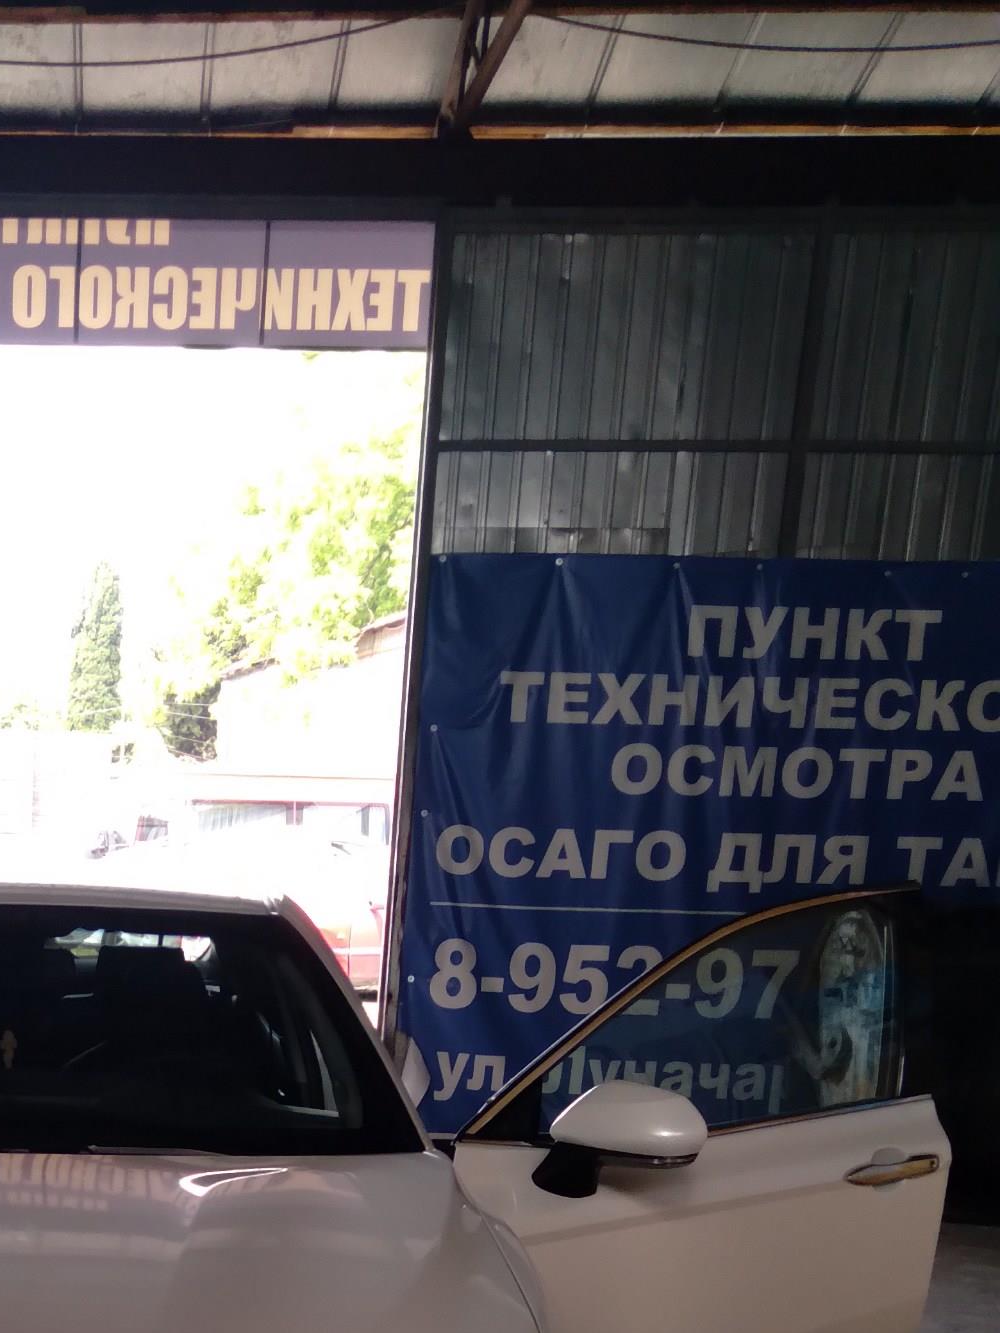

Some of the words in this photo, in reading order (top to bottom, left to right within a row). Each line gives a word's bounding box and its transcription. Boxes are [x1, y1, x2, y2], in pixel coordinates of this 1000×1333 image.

[687, 605, 943, 662] ПУНКТ
[501, 670, 1000, 733] ТЕХНИЧЕСКО
[611, 743, 983, 801] ОСМОТРА
[436, 824, 687, 880] ОСАГО
[706, 832, 870, 893] ДЛЯ
[897, 836, 1000, 887] ТА
